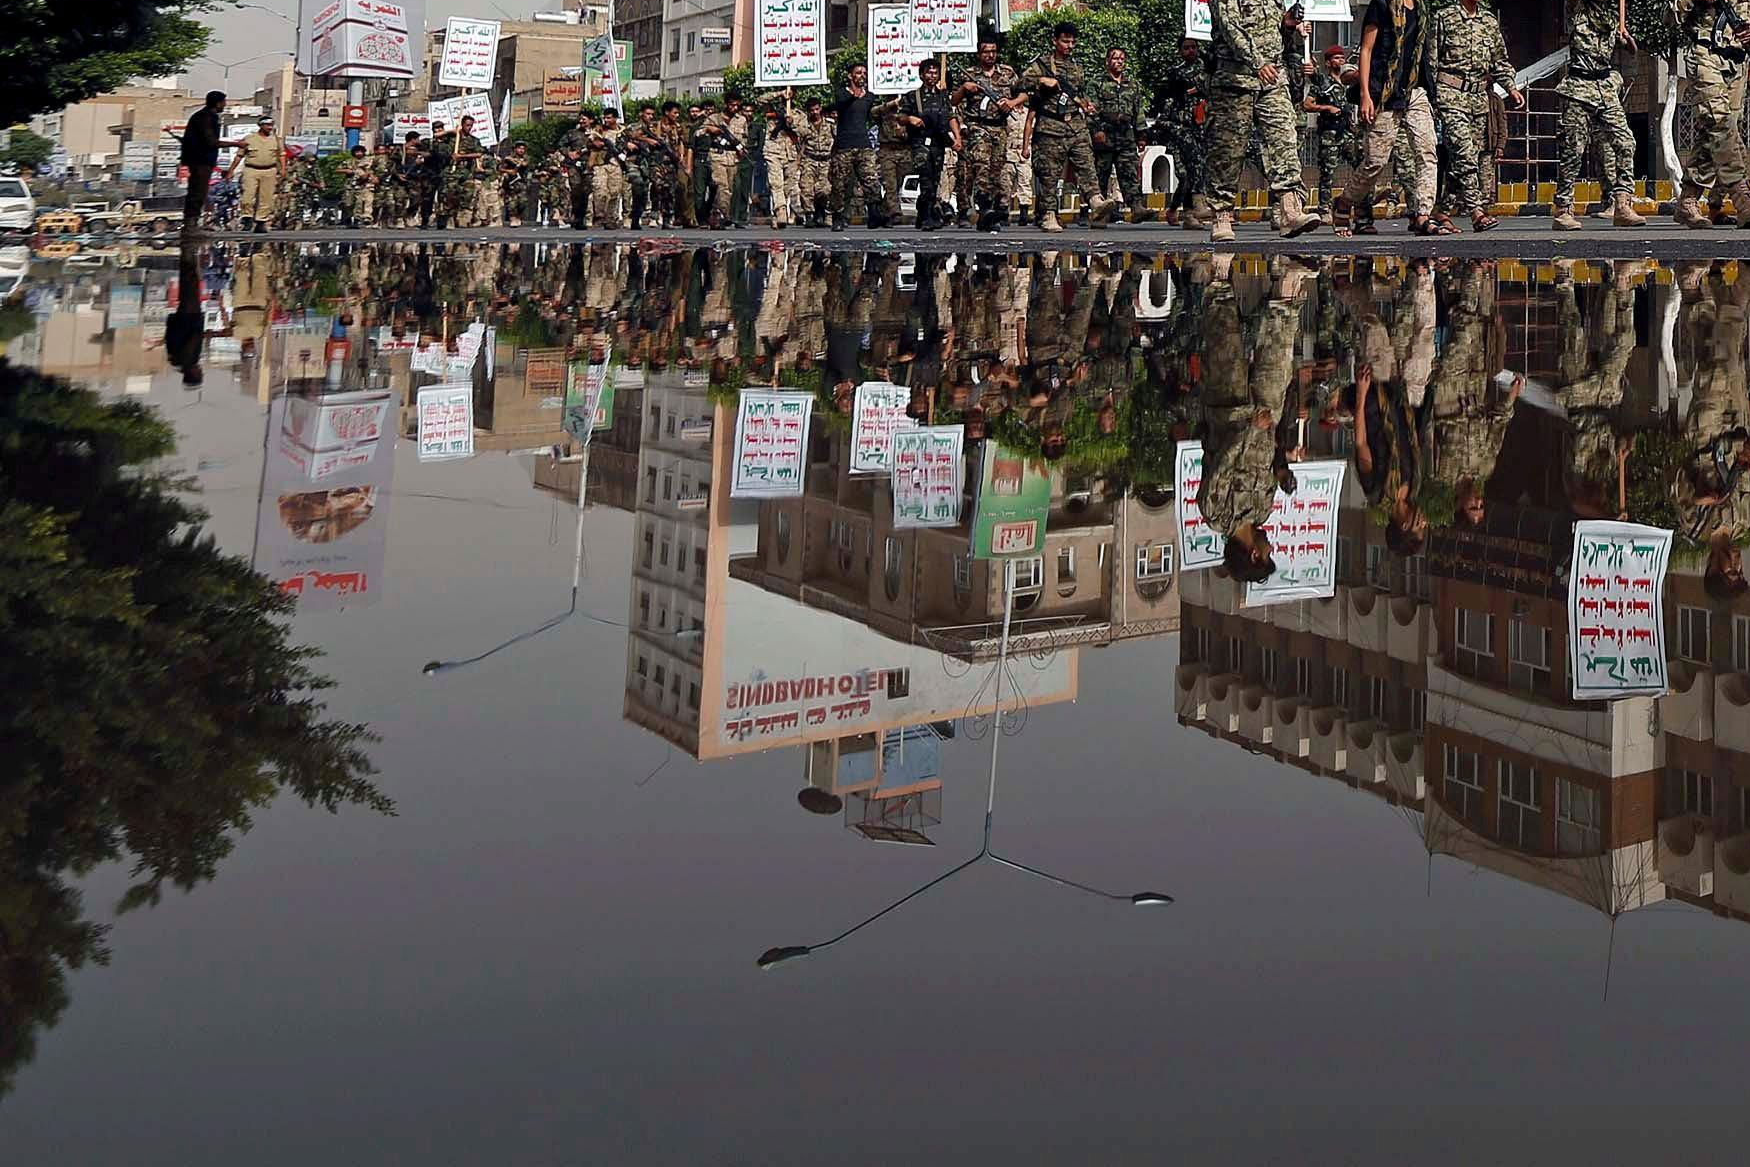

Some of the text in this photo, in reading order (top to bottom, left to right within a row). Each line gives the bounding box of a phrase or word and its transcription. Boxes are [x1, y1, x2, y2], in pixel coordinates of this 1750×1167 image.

[798, 0, 817, 11] الله
[948, 0, 970, 9] الموت
[795, 18, 817, 28] الموت
[877, 10, 908, 28] أكبر
[795, 33, 817, 44] الموت
[945, 27, 969, 44] النصر
[764, 60, 818, 78] النصر للإسلام
